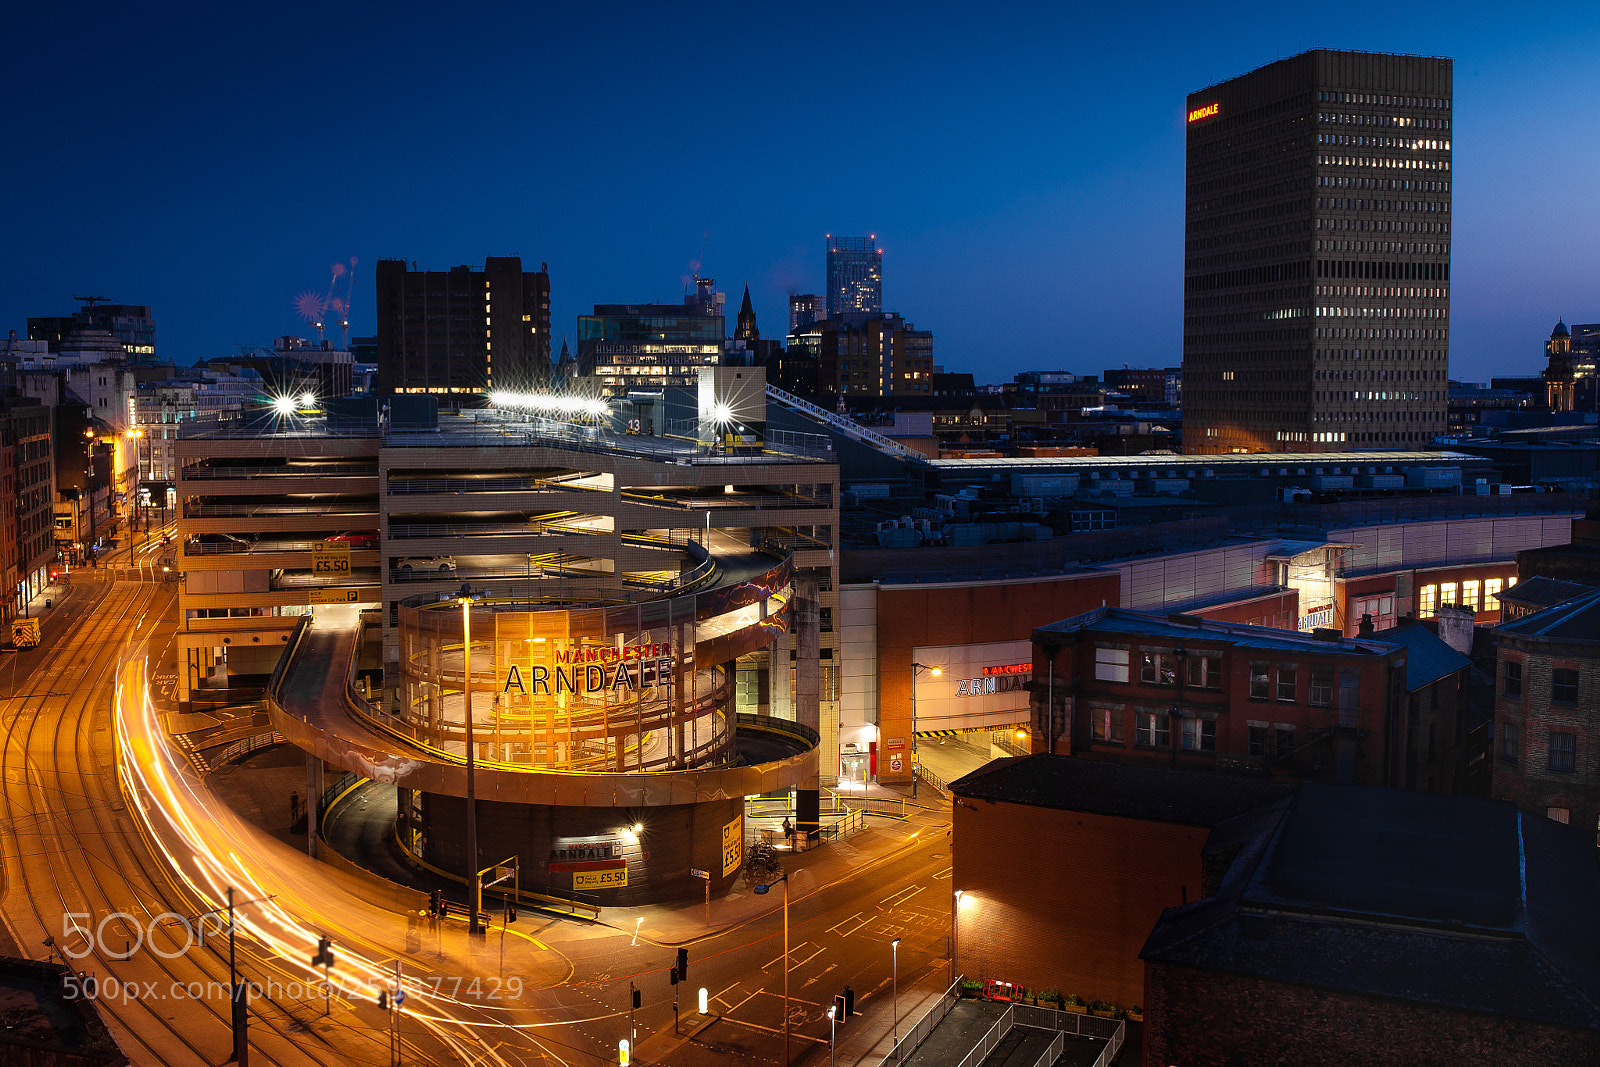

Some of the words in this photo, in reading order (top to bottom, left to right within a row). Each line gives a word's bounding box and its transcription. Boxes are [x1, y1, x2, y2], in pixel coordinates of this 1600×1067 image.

[1188, 103, 1219, 122] ARNDALE
[628, 419, 640, 431] 13
[315, 560, 349, 572] £5.50
[1298, 609, 1333, 630] ARNDALE
[555, 642, 671, 664] MANCHESTER
[503, 657, 672, 695] ARNDALE
[962, 726, 979, 734] MAX
[985, 723, 1013, 732] HEIGHT
[550, 847, 610, 859] ARNDALE
[600, 871, 626, 883] £5.50
